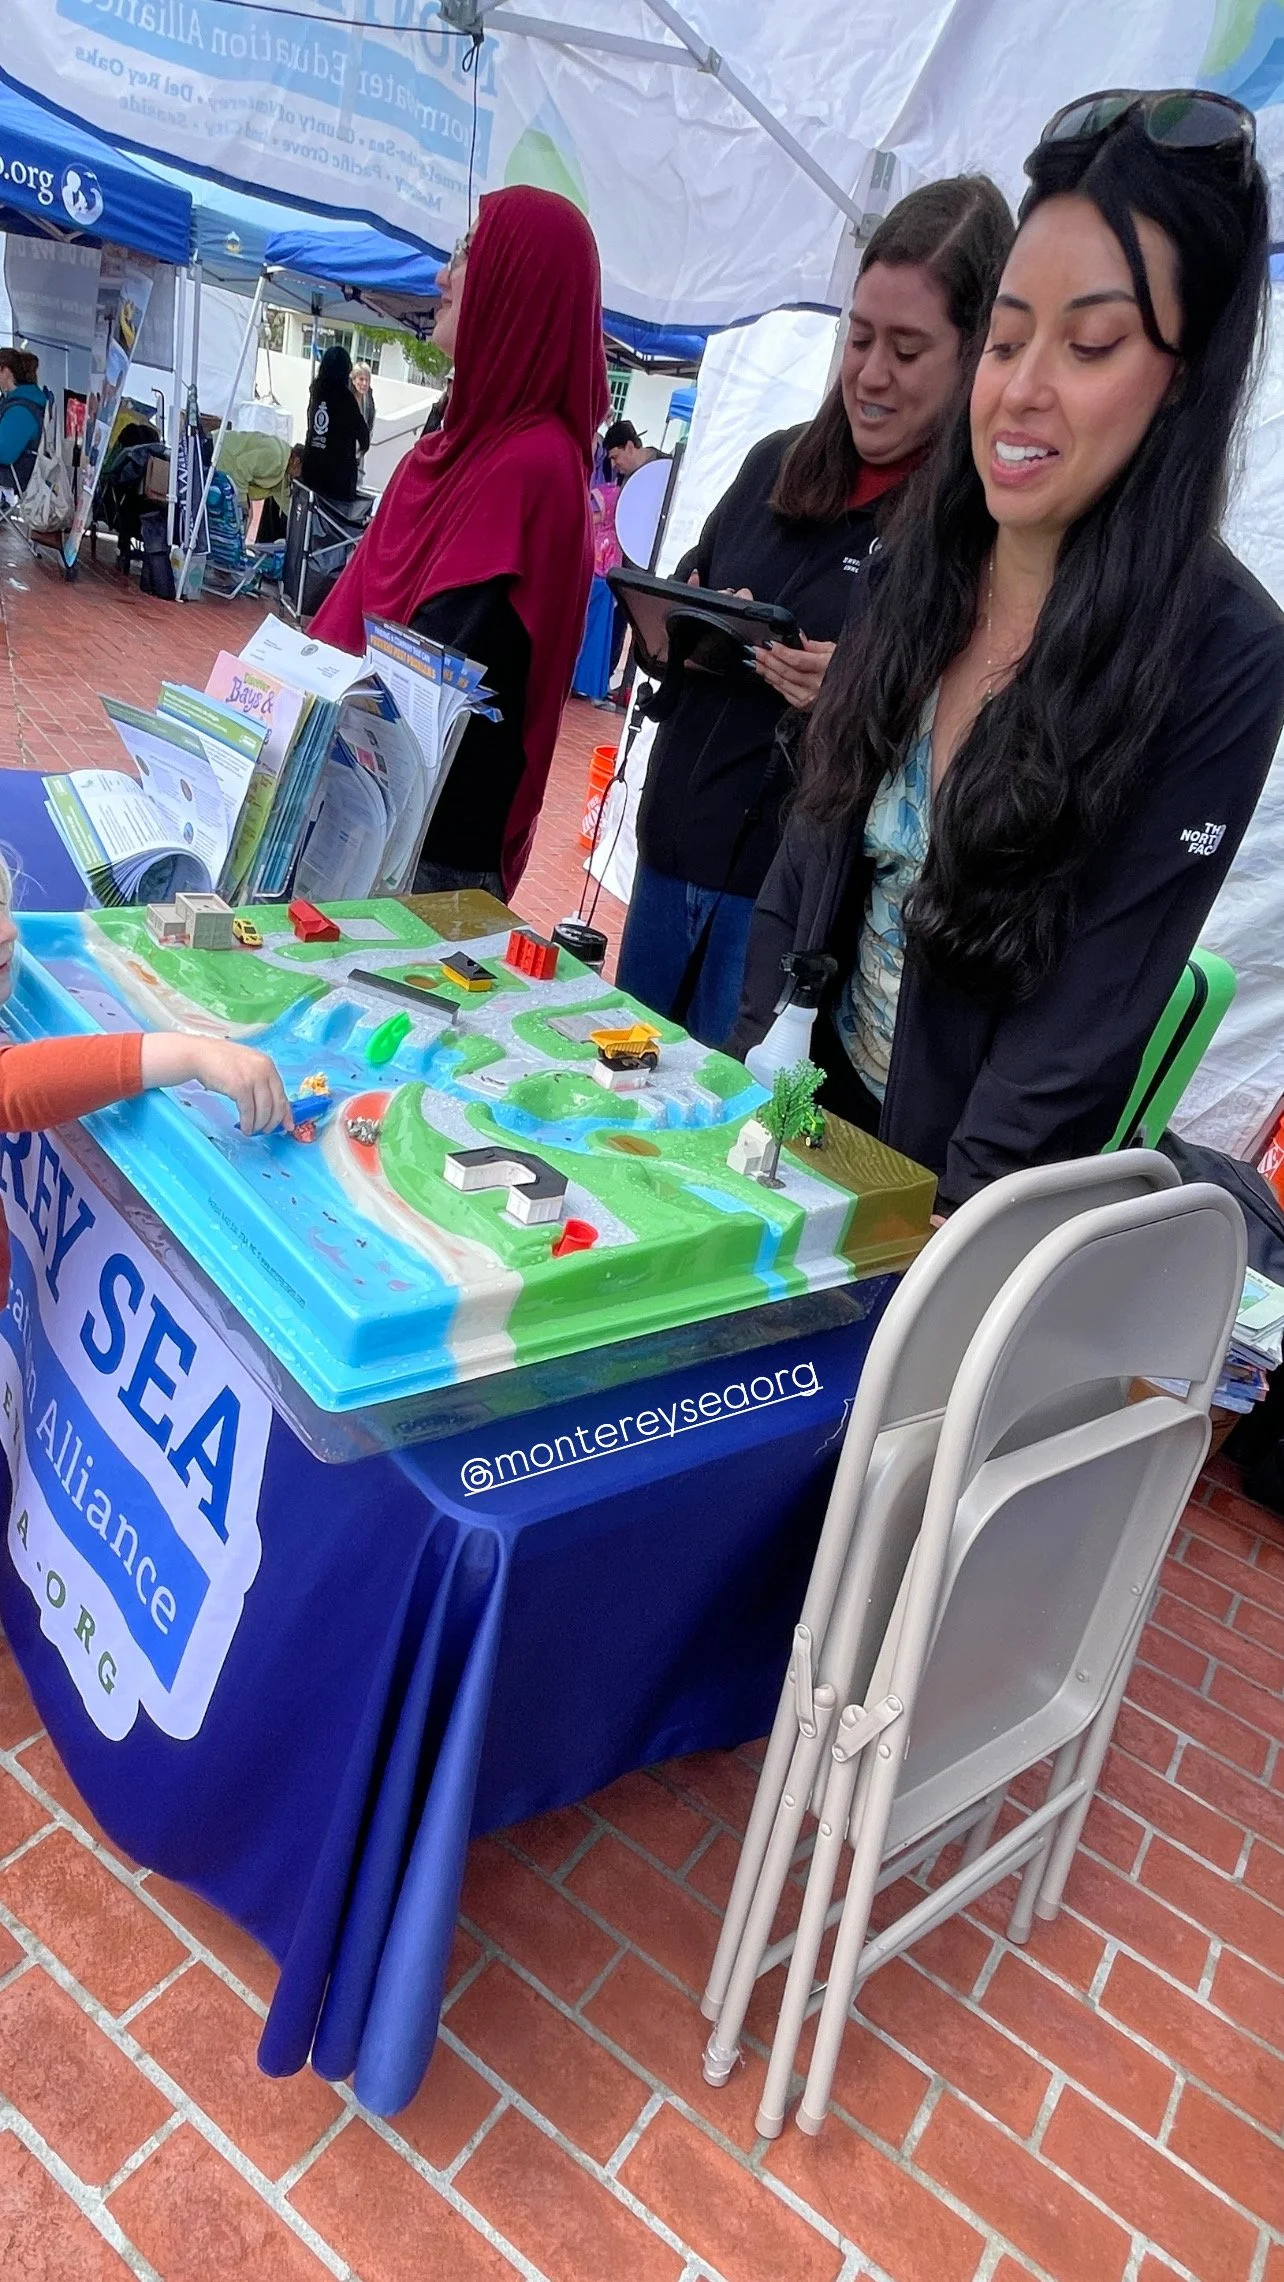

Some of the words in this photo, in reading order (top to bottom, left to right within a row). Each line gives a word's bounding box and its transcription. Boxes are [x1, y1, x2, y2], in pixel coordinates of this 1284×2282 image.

[225, 676, 263, 713] Bays
[260, 691, 275, 714] &
[1180, 829, 1218, 845] NORT
[1205, 822, 1222, 835] TH
[1188, 842, 1214, 856] FAC
[80, 1253, 241, 1545] SEA
[36, 1398, 177, 1635] Alliance
